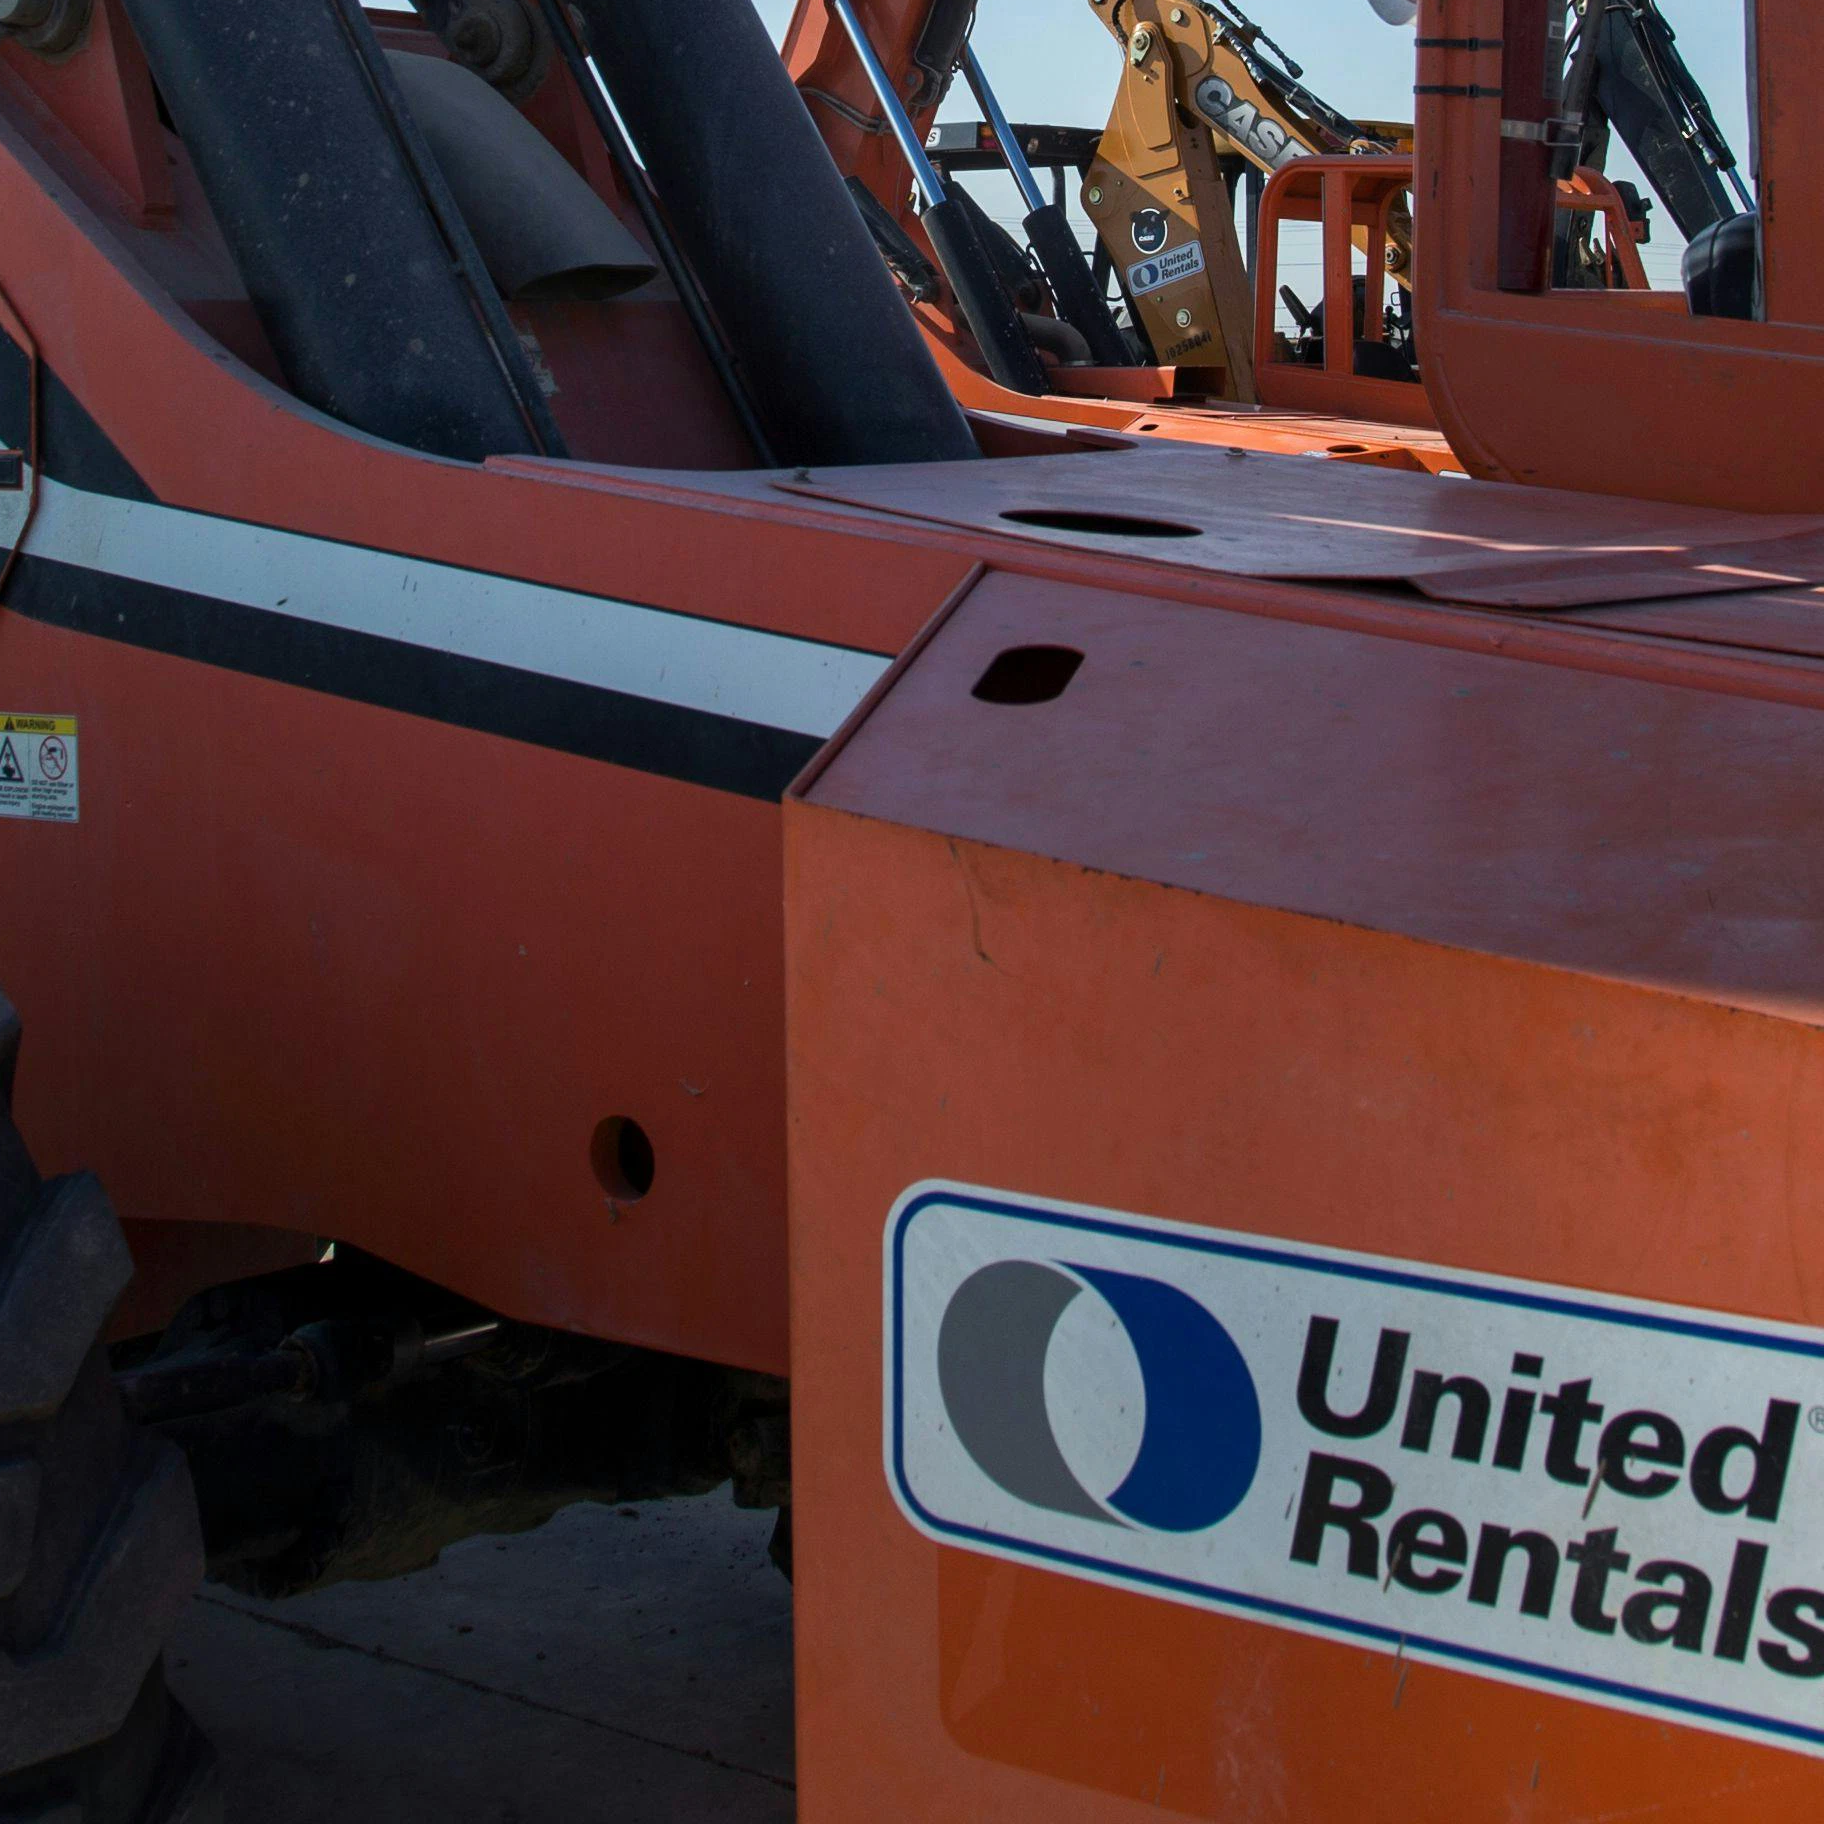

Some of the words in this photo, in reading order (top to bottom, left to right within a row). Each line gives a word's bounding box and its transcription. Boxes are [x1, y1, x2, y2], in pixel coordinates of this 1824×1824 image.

[1159, 248, 1193, 269] United
[1161, 258, 1199, 279] Rentals
[16, 718, 56, 731] WARNING
[1296, 1315, 1801, 1522] United
